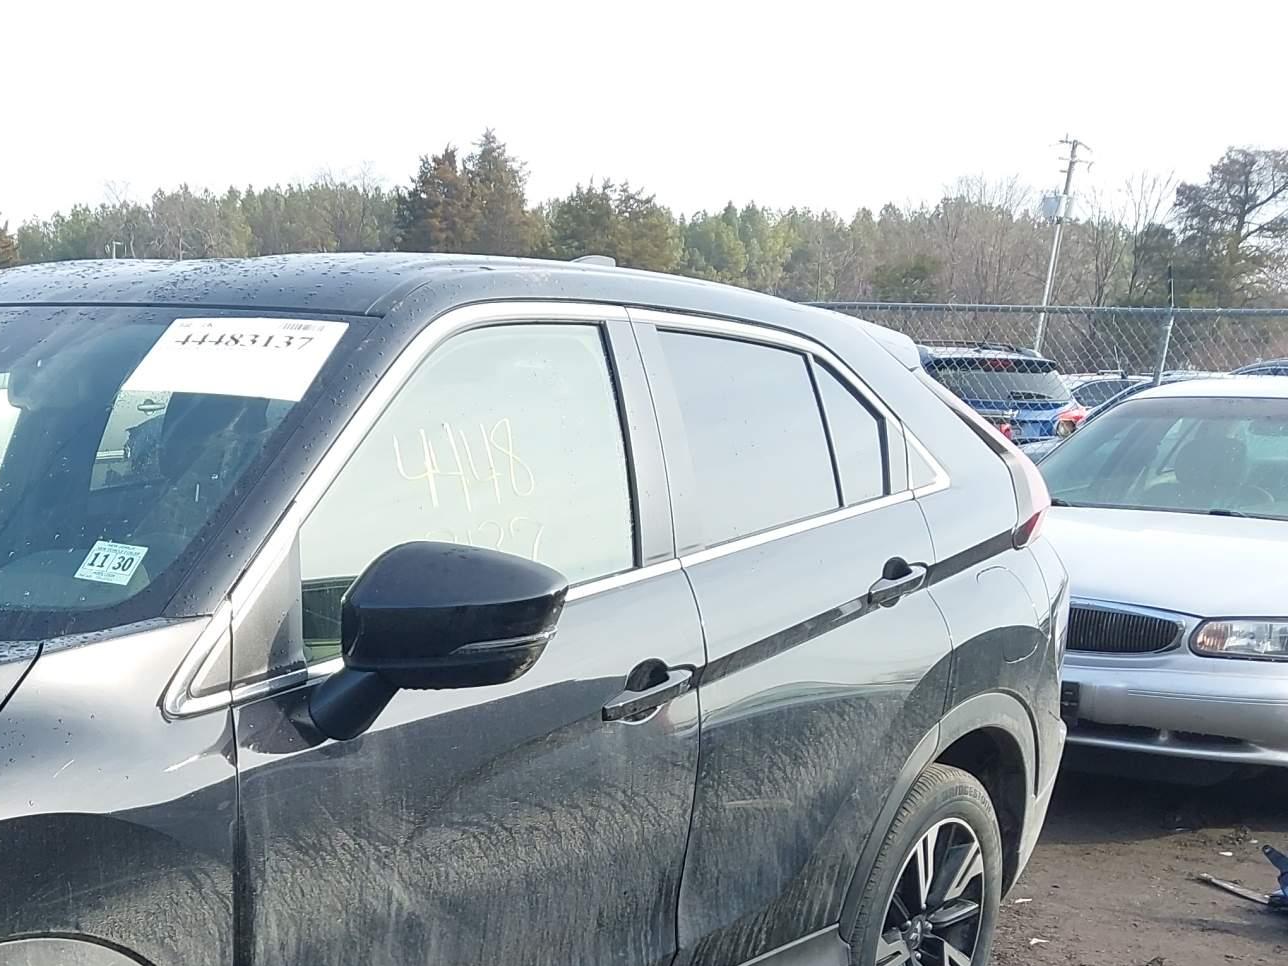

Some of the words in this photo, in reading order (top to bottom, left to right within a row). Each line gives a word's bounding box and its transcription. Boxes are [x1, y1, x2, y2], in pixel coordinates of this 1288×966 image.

[175, 332, 315, 350] 44483137
[87, 552, 110, 568] 11
[112, 555, 134, 571] 30
